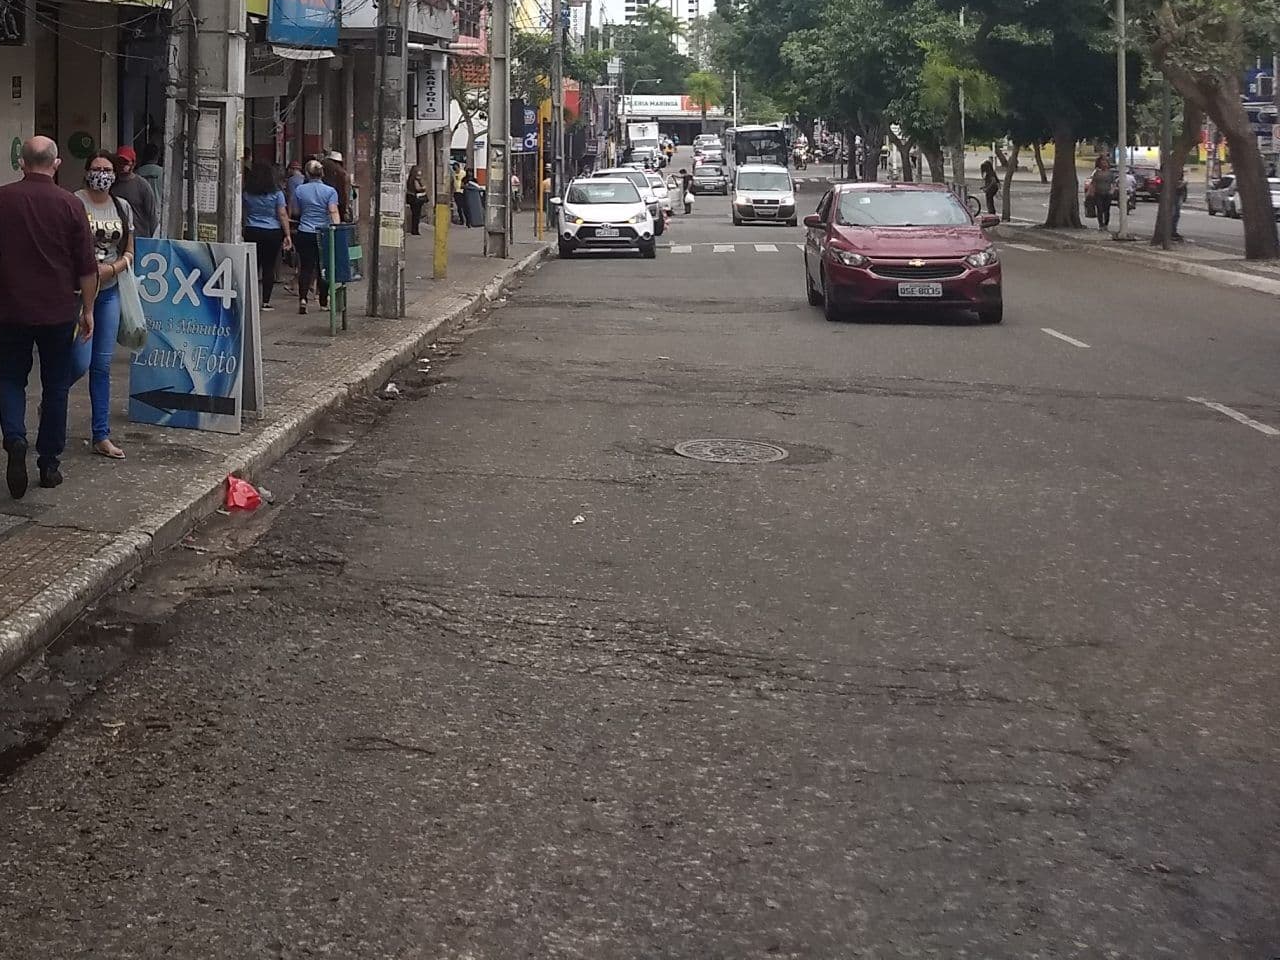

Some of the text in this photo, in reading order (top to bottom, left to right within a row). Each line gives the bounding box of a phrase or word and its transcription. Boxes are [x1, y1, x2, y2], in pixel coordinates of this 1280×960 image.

[137, 252, 237, 310] 3x4
[176, 319, 232, 337] Minutos
[192, 345, 237, 374] Foto
